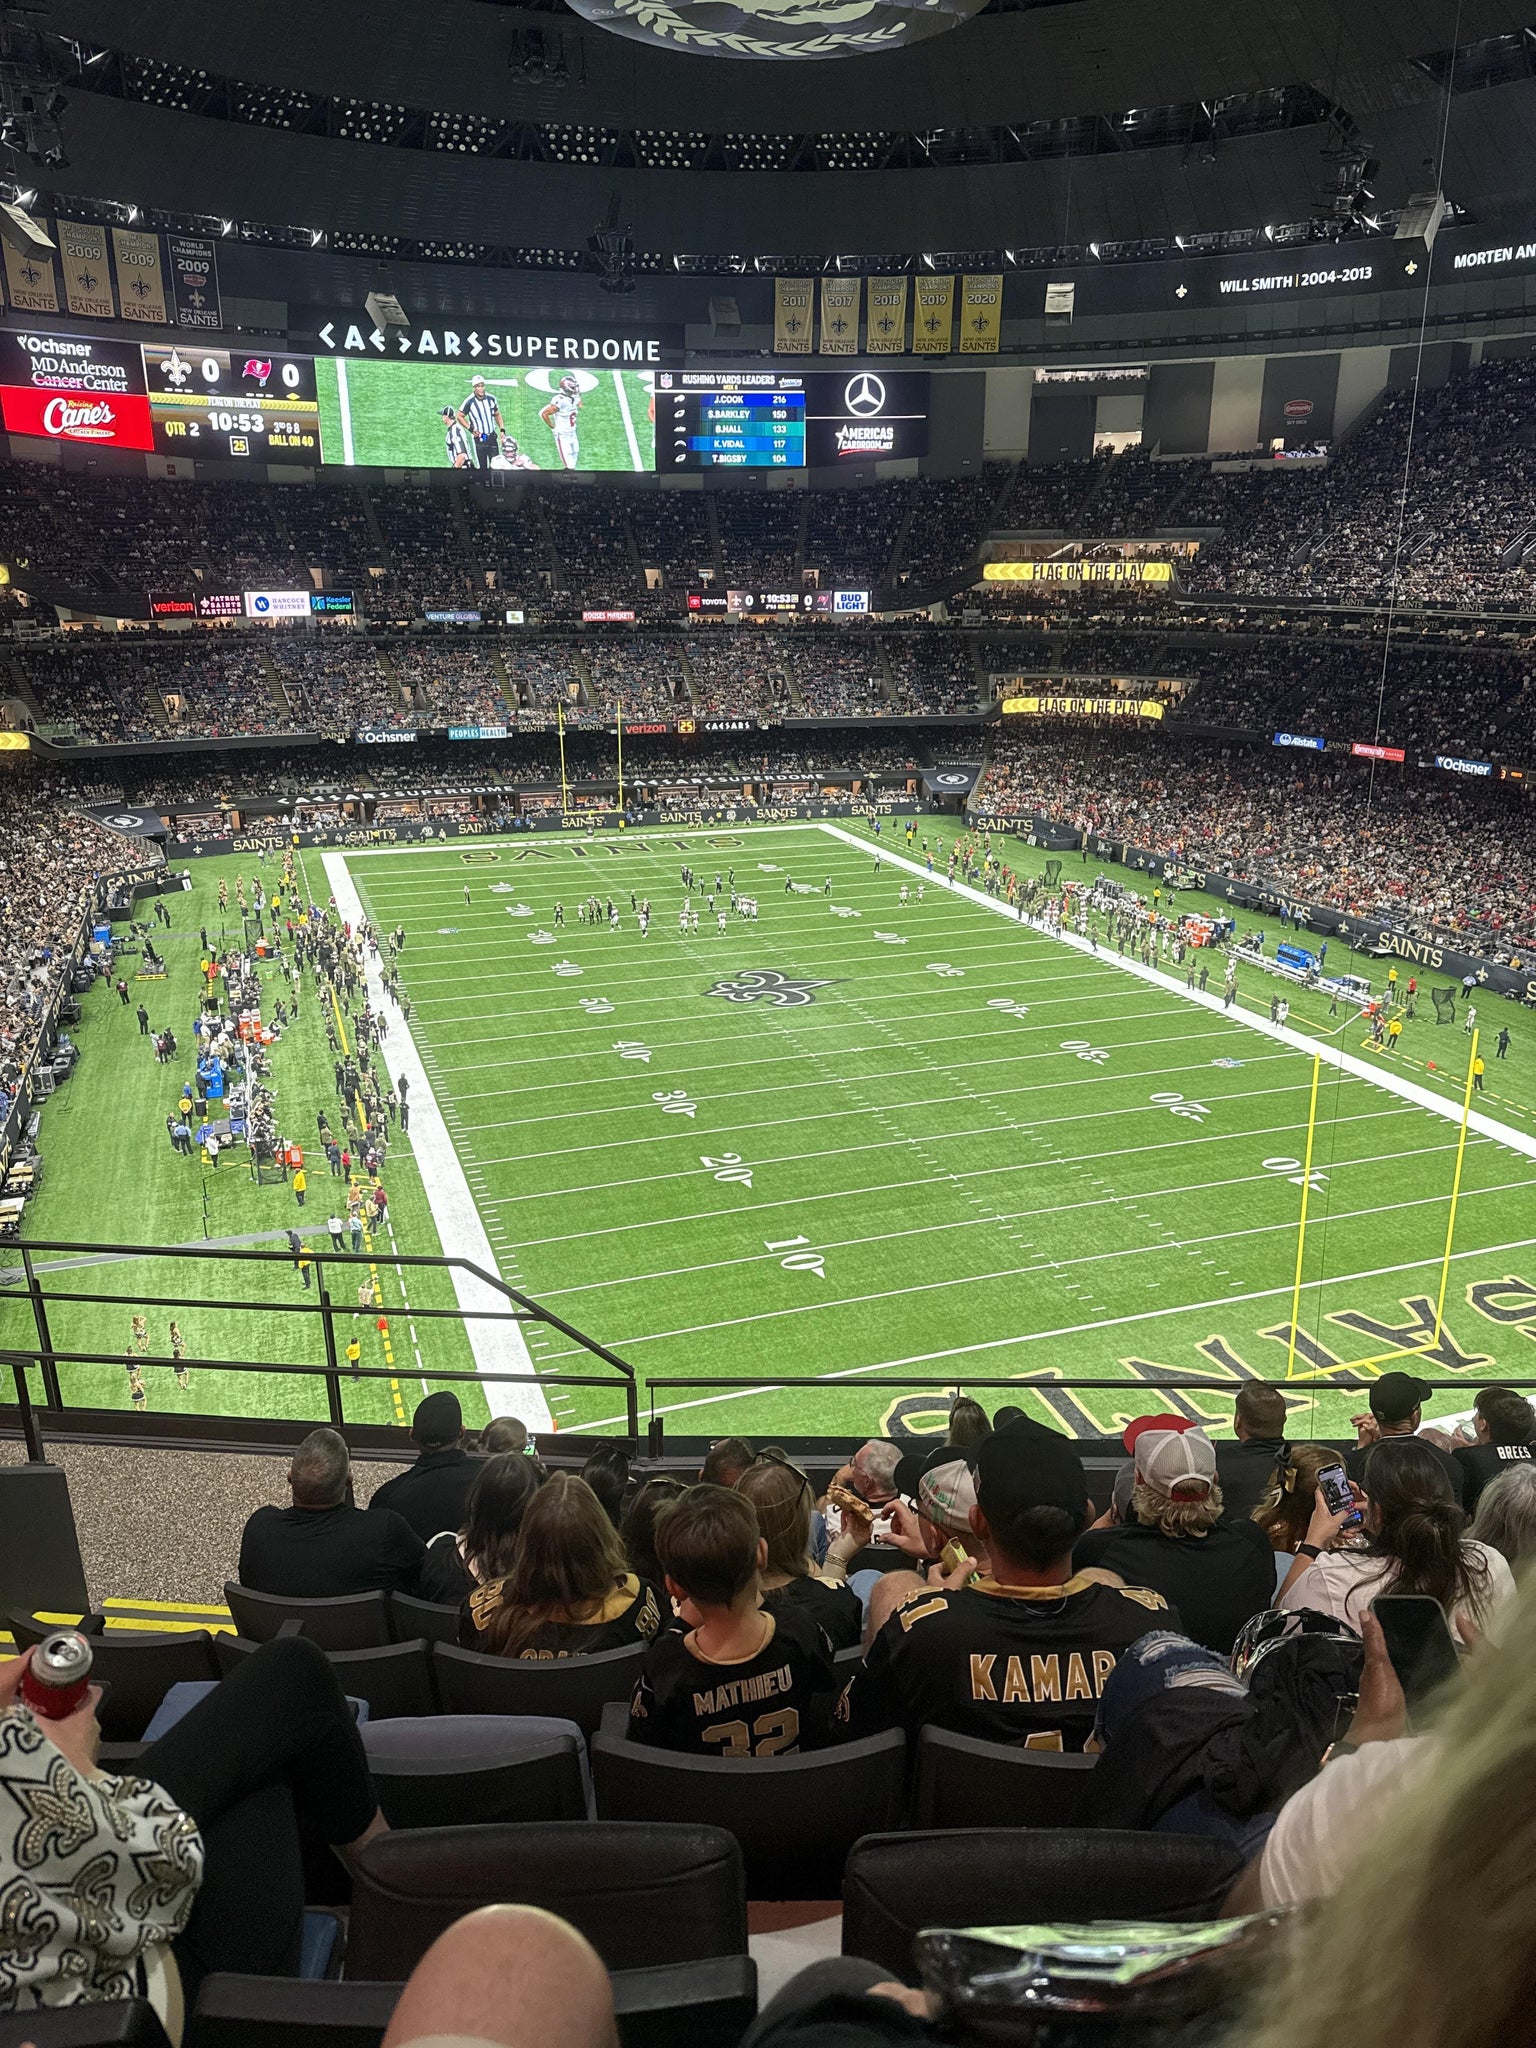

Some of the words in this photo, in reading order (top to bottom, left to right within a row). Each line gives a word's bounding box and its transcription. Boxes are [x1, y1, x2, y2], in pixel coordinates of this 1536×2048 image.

[179, 240, 204, 249] WORLD
[67, 244, 102, 260] 2009
[172, 246, 212, 257] CHAMPIONS
[121, 251, 155, 267] 2009
[1454, 247, 1513, 269] MORTEN
[177, 259, 210, 273] 2009
[1220, 279, 1250, 293] WILL
[1252, 275, 1292, 291] SMITH
[1301, 266, 1372, 286] 2004-2013
[14, 295, 55, 310] SAINTS
[782, 295, 806, 307] 2011
[828, 295, 854, 307] 2017
[874, 294, 900, 306] 2018
[921, 293, 947, 305] 2019
[967, 293, 996, 304] 2020
[71, 301, 111, 316] SAINTS
[124, 307, 163, 321] SAINTS
[180, 314, 218, 326] SAINTS
[27, 337, 92, 356] Ochsner
[488, 333, 661, 361] SUPERDOME
[777, 343, 810, 352] SAINTS
[822, 343, 855, 353] SAINTS
[869, 342, 902, 352] SAINTS
[915, 342, 948, 352] SAINTS
[962, 342, 996, 351] SAINTS
[30, 356, 58, 372] MD
[60, 359, 126, 378] Anderson
[202, 358, 220, 382] 0
[282, 364, 300, 388] 0
[32, 371, 82, 388] Cancer
[83, 375, 128, 391] Center
[682, 375, 715, 385] RUSHING
[716, 375, 741, 385] YARDS
[742, 375, 776, 385] LEADERS
[68, 400, 93, 409] Raising
[714, 395, 744, 404] J.COOK
[772, 395, 787, 404] 216
[44, 398, 115, 434] Cane's
[708, 410, 750, 419] S.BARKLEY
[772, 410, 787, 419] 150
[208, 412, 265, 433] 10:53
[293, 423, 300, 434] 8
[165, 421, 186, 437] QTR
[189, 422, 200, 437] 2
[715, 425, 743, 434] B.HALL
[773, 425, 787, 434] 133
[840, 425, 894, 441] AMERICAS
[233, 440, 246, 452] 25
[269, 435, 288, 446] BALL
[289, 436, 300, 446] ON
[301, 436, 314, 447] 40
[714, 440, 745, 448] K.VIDAL
[773, 440, 786, 448] 117
[712, 454, 747, 463] T.BIGSBY
[772, 454, 787, 463] 104
[1033, 564, 1062, 580] FLAG
[1067, 564, 1084, 580] ON
[1088, 564, 1111, 580] THE
[1114, 563, 1146, 580] PLAY
[745, 595, 754, 606] 0
[767, 594, 791, 603] 10:53
[804, 595, 813, 606] 0
[841, 594, 862, 602] BUD
[153, 601, 194, 612] verizon
[836, 602, 866, 610] LIGHT
[1396, 601, 1424, 609] SAINTS
[1455, 603, 1484, 612] SAINTS
[583, 612, 606, 620] ROUSES
[1038, 699, 1066, 712] FLAG
[1071, 699, 1085, 712] ON
[1089, 700, 1110, 713] THE
[1115, 700, 1141, 715] PLAY
[625, 723, 666, 734] verizon
[680, 722, 693, 731] 25
[705, 722, 750, 730] CAESARS
[321, 732, 350, 740] SAINTS
[365, 732, 416, 743] Ochsner
[450, 728, 479, 738] PEOPLES
[481, 728, 507, 737] HEALTH
[1291, 737, 1318, 748] Allstate
[1327, 740, 1351, 751] SAINTS
[1443, 758, 1489, 776] Ochsner
[719, 773, 825, 782] SUPERDOME
[1500, 769, 1506, 779] 3
[277, 790, 390, 805] CAESARS
[392, 785, 515, 798] SUPERDOME
[757, 807, 797, 819] SAINTS
[851, 804, 892, 815] SAINTS
[660, 811, 702, 823] SAINTS
[977, 817, 1034, 831] SAINTS
[233, 837, 283, 852] SAINTS
[459, 836, 745, 865] SAINTS
[1378, 931, 1443, 968] SAINTS
[578, 997, 615, 1013] 50
[612, 1040, 652, 1061] 40
[1059, 1040, 1110, 1065] 30
[652, 1089, 697, 1116] 30
[1149, 1092, 1212, 1121] 20
[699, 1152, 753, 1185] 20
[1262, 1156, 1331, 1190] 10
[763, 1234, 825, 1276] 10
[1496, 1445, 1532, 1459] BREES
[969, 1651, 1117, 1703] KAMAR
[692, 1663, 793, 1716] MATHIEU
[702, 1706, 800, 1758] 32
